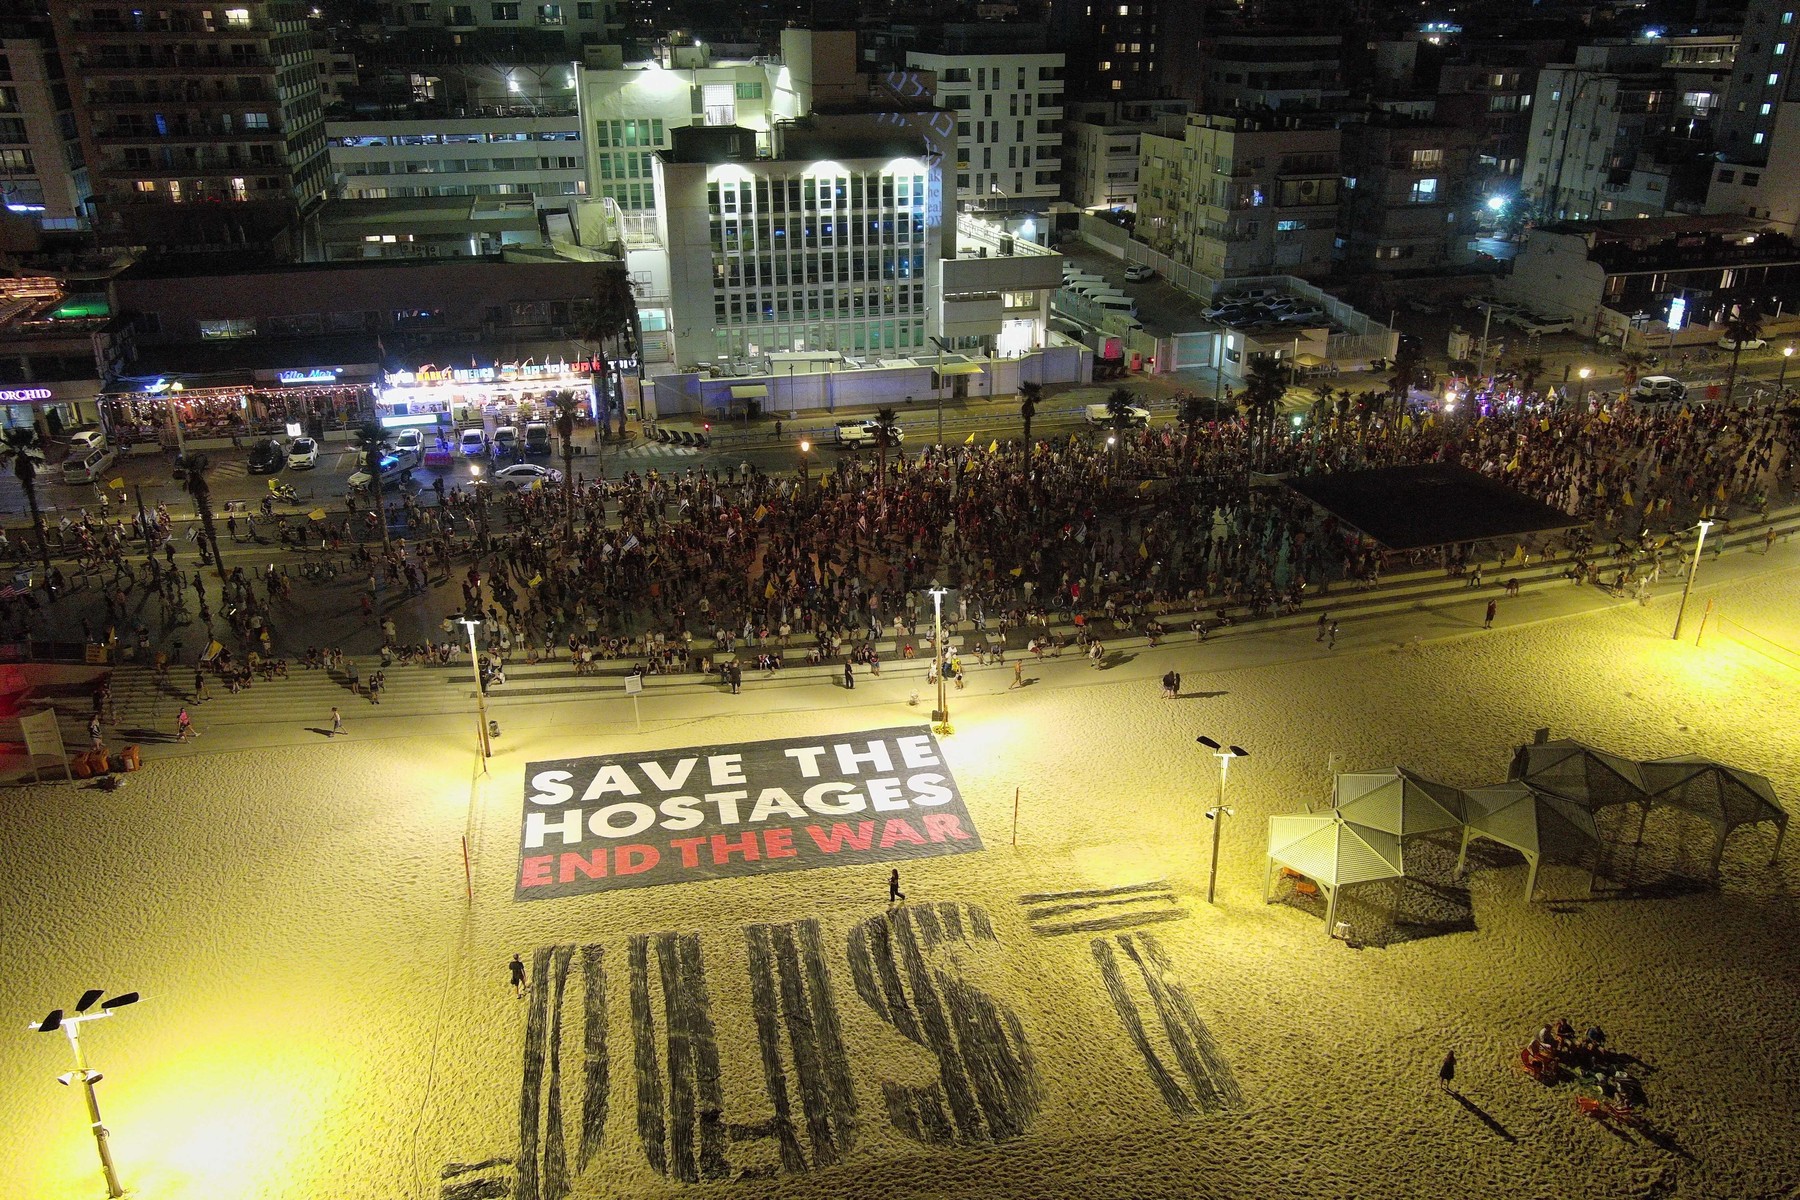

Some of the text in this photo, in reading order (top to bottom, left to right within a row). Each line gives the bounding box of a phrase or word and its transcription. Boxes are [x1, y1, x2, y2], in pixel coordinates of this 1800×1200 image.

[279, 371, 304, 381] Villa
[454, 367, 495, 380] AMERICA
[0, 388, 52, 401] ORCHID
[529, 735, 940, 805] SAVE THE
[524, 773, 953, 848] HOSTAGES
[521, 813, 971, 887] END THE WAR
